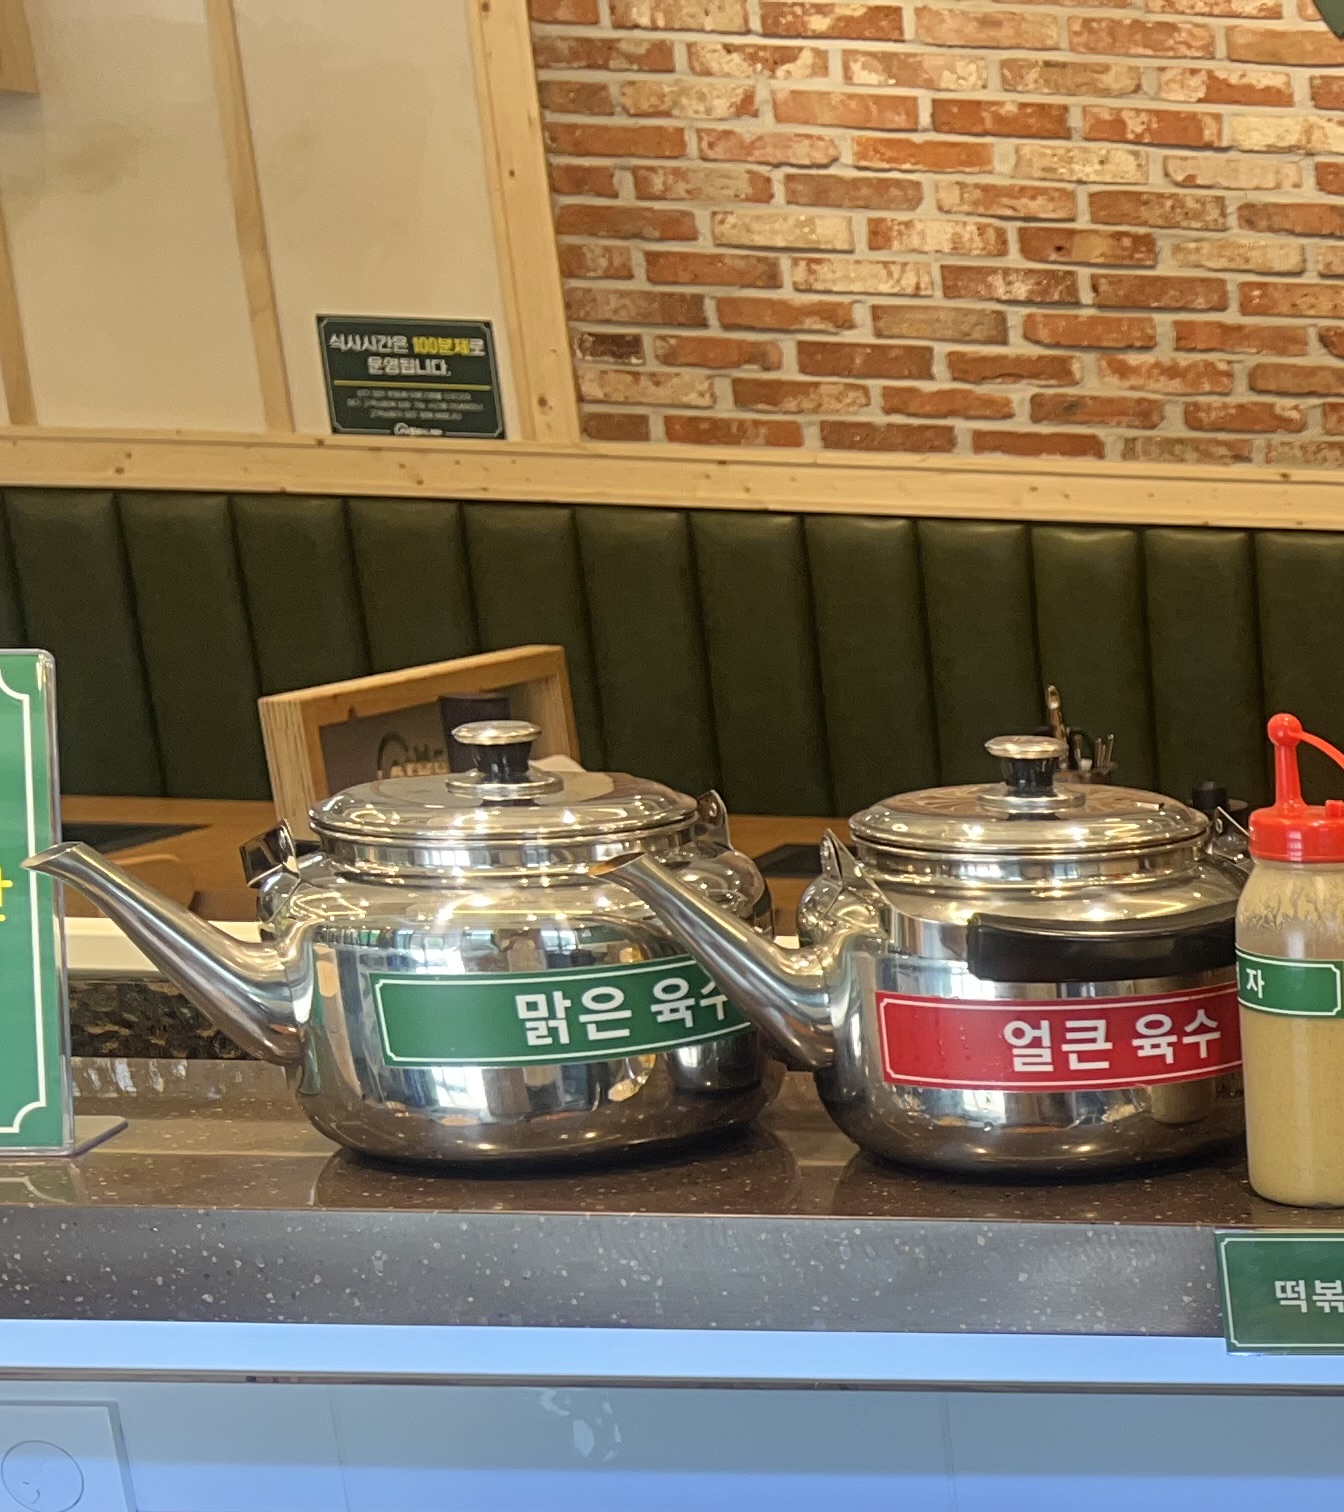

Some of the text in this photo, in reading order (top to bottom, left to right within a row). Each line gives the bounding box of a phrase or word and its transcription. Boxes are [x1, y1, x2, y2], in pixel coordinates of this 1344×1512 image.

[329, 333, 409, 353] 식사시간은
[515, 986, 633, 1047] 맑은
[1003, 1008, 1222, 1073] 얼큰 육수
